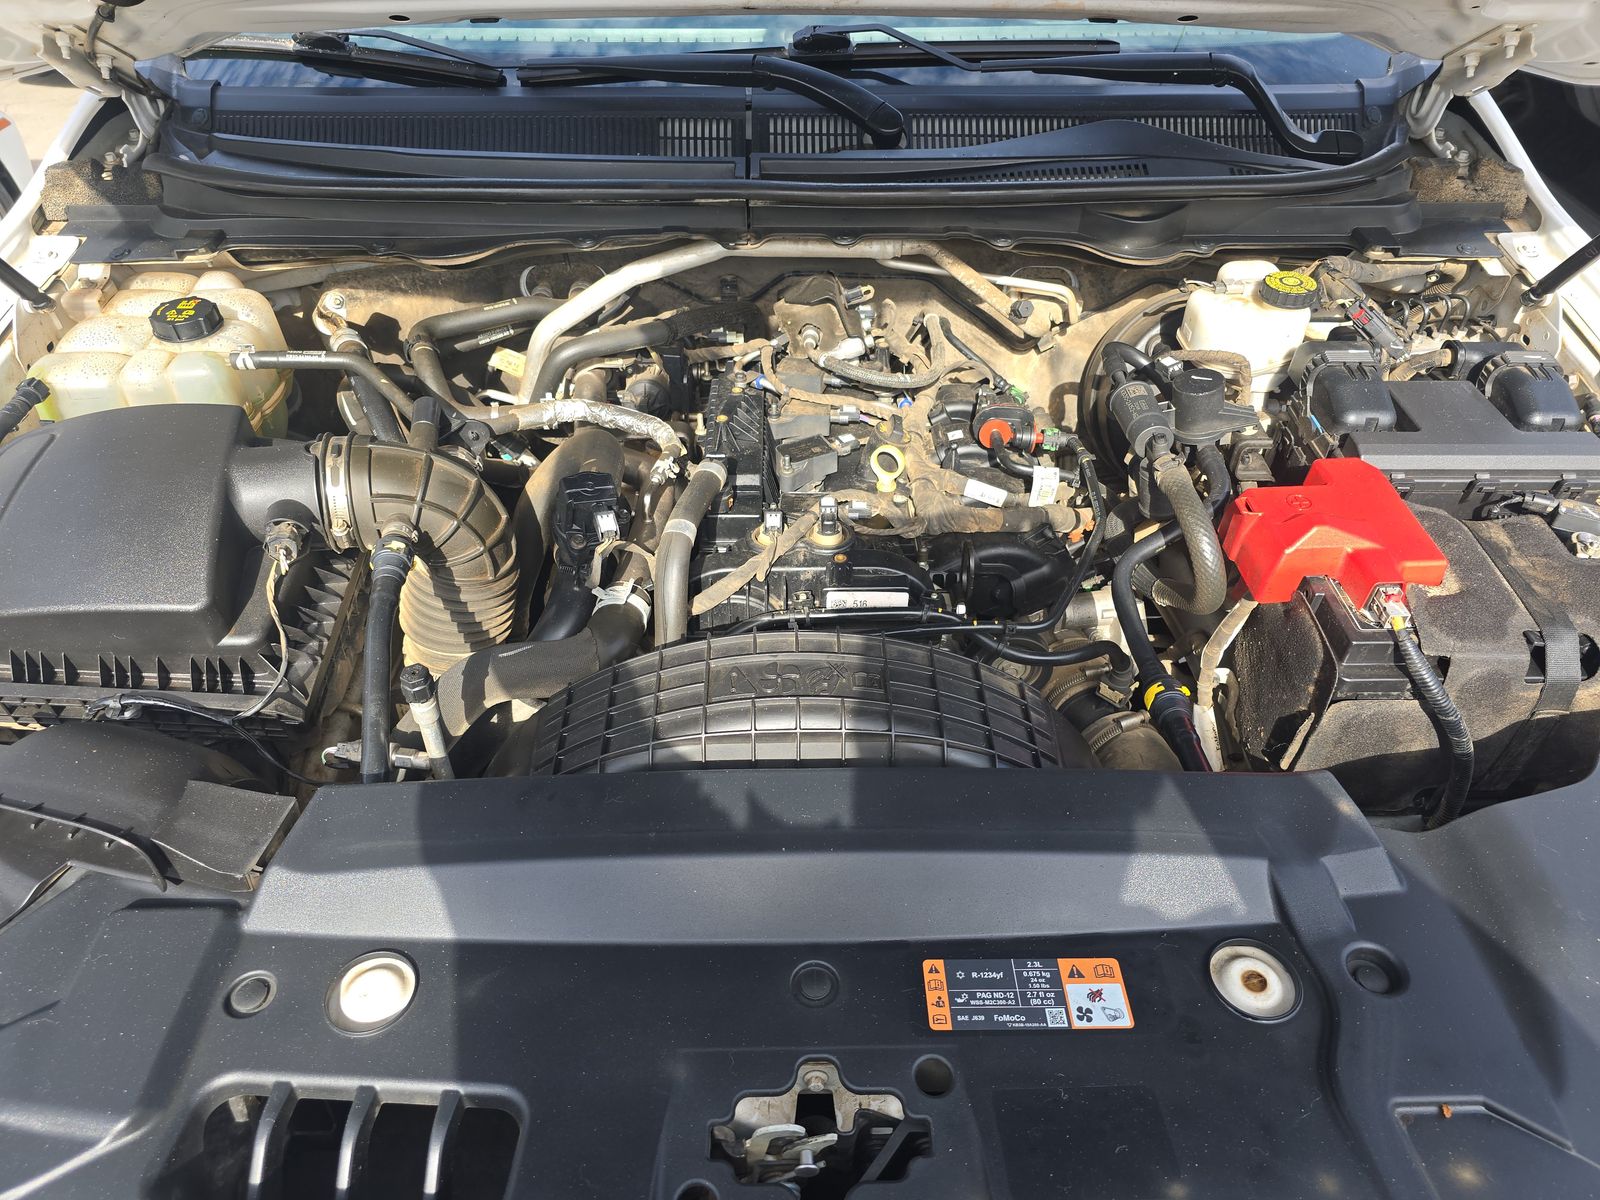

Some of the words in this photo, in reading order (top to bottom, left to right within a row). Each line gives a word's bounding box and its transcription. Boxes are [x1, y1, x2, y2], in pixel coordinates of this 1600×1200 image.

[971, 971, 1004, 980] R-1234yf
[1041, 970, 1051, 978] kg
[1029, 998, 1042, 1006] (80
[1043, 998, 1055, 1006] cc)
[993, 1014, 1026, 1022] FoMoCo
